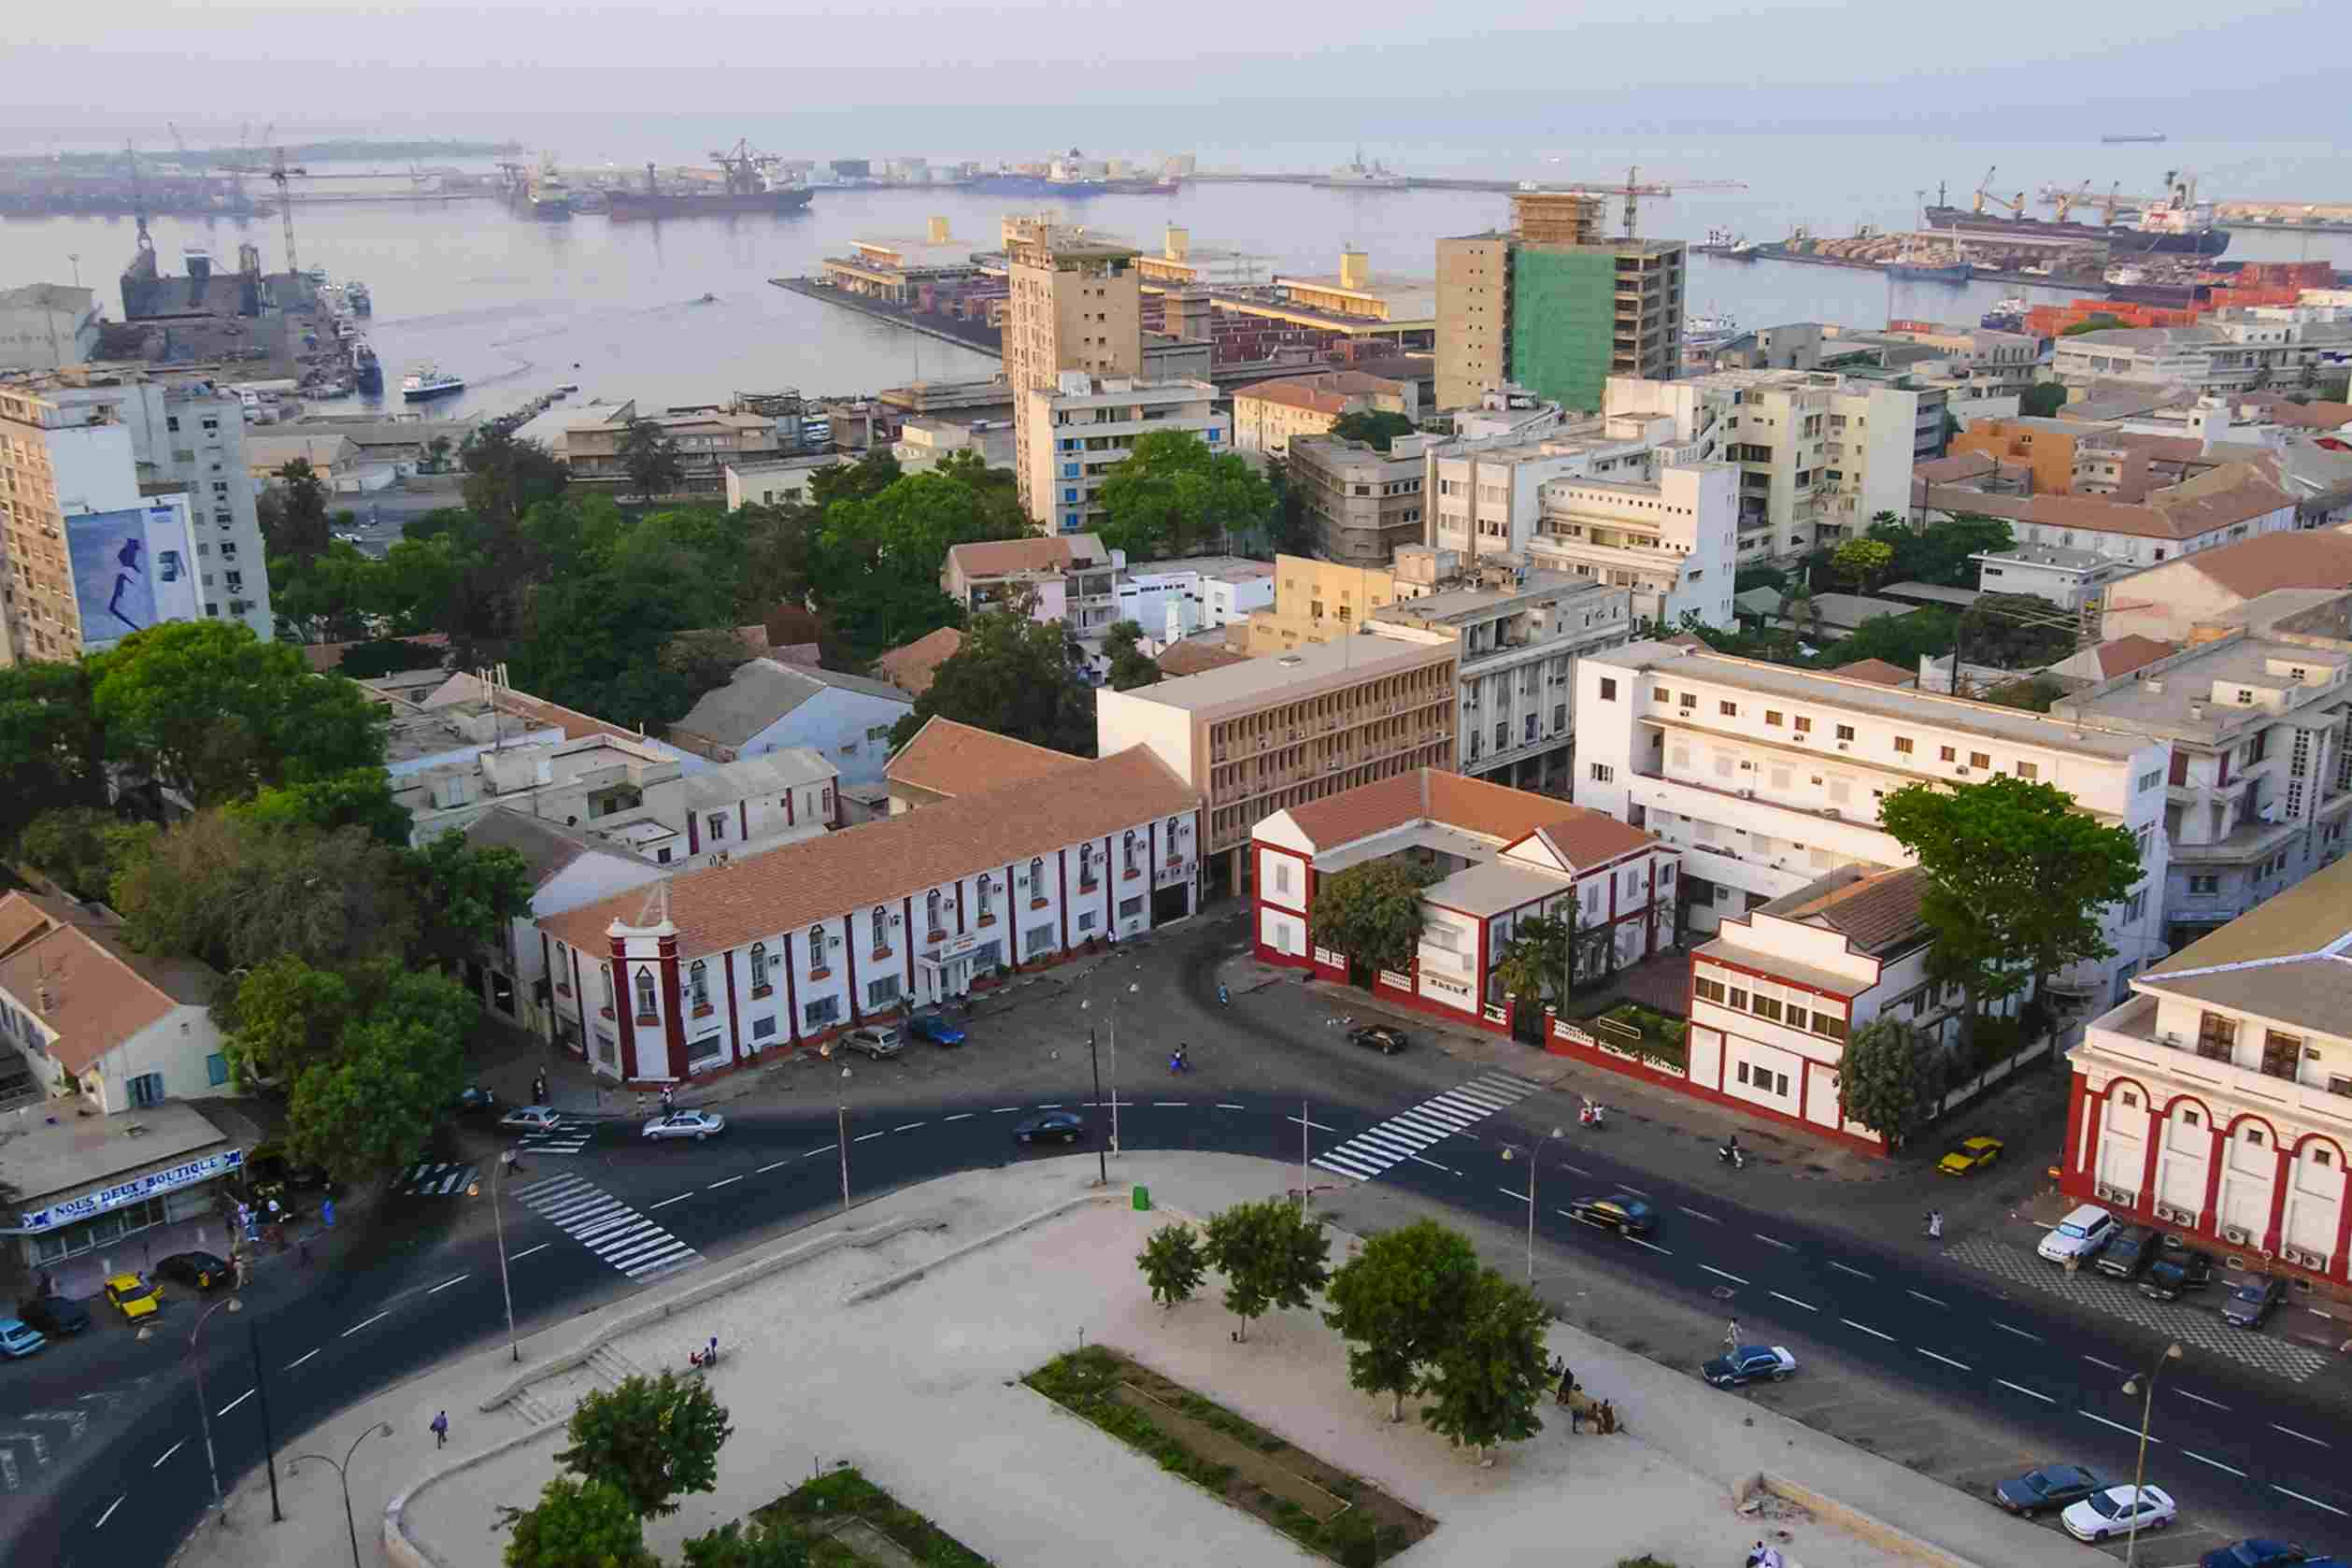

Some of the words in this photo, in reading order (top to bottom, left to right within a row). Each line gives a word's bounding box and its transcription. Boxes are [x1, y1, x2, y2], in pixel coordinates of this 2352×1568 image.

[55, 1197, 94, 1216] NOUS
[100, 1181, 140, 1203] DEUX
[147, 1157, 218, 1188] BOUTIQUE
